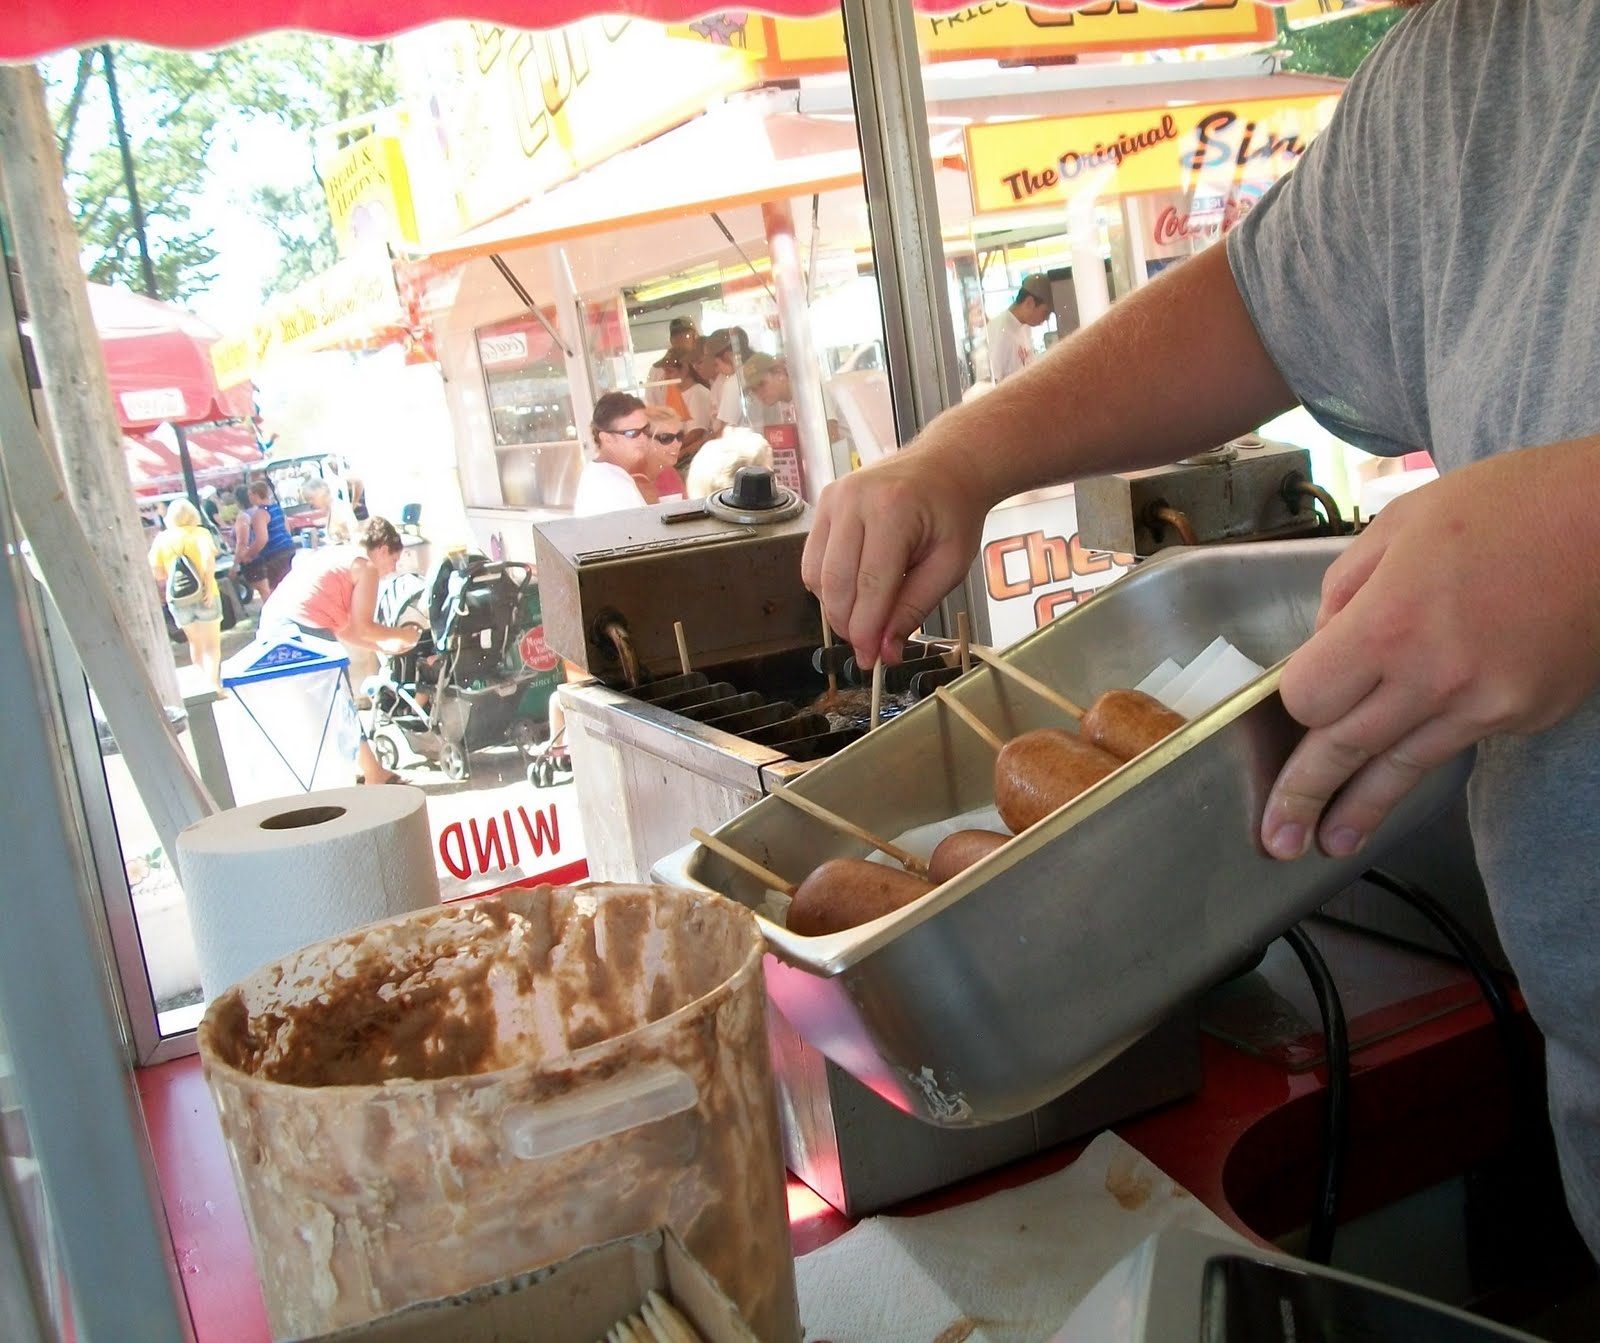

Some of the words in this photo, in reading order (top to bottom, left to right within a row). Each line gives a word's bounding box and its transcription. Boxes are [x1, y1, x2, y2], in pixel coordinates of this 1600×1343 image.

[1002, 168, 1058, 201] The
[1058, 114, 1177, 179] Original
[983, 530, 1134, 602] Che
